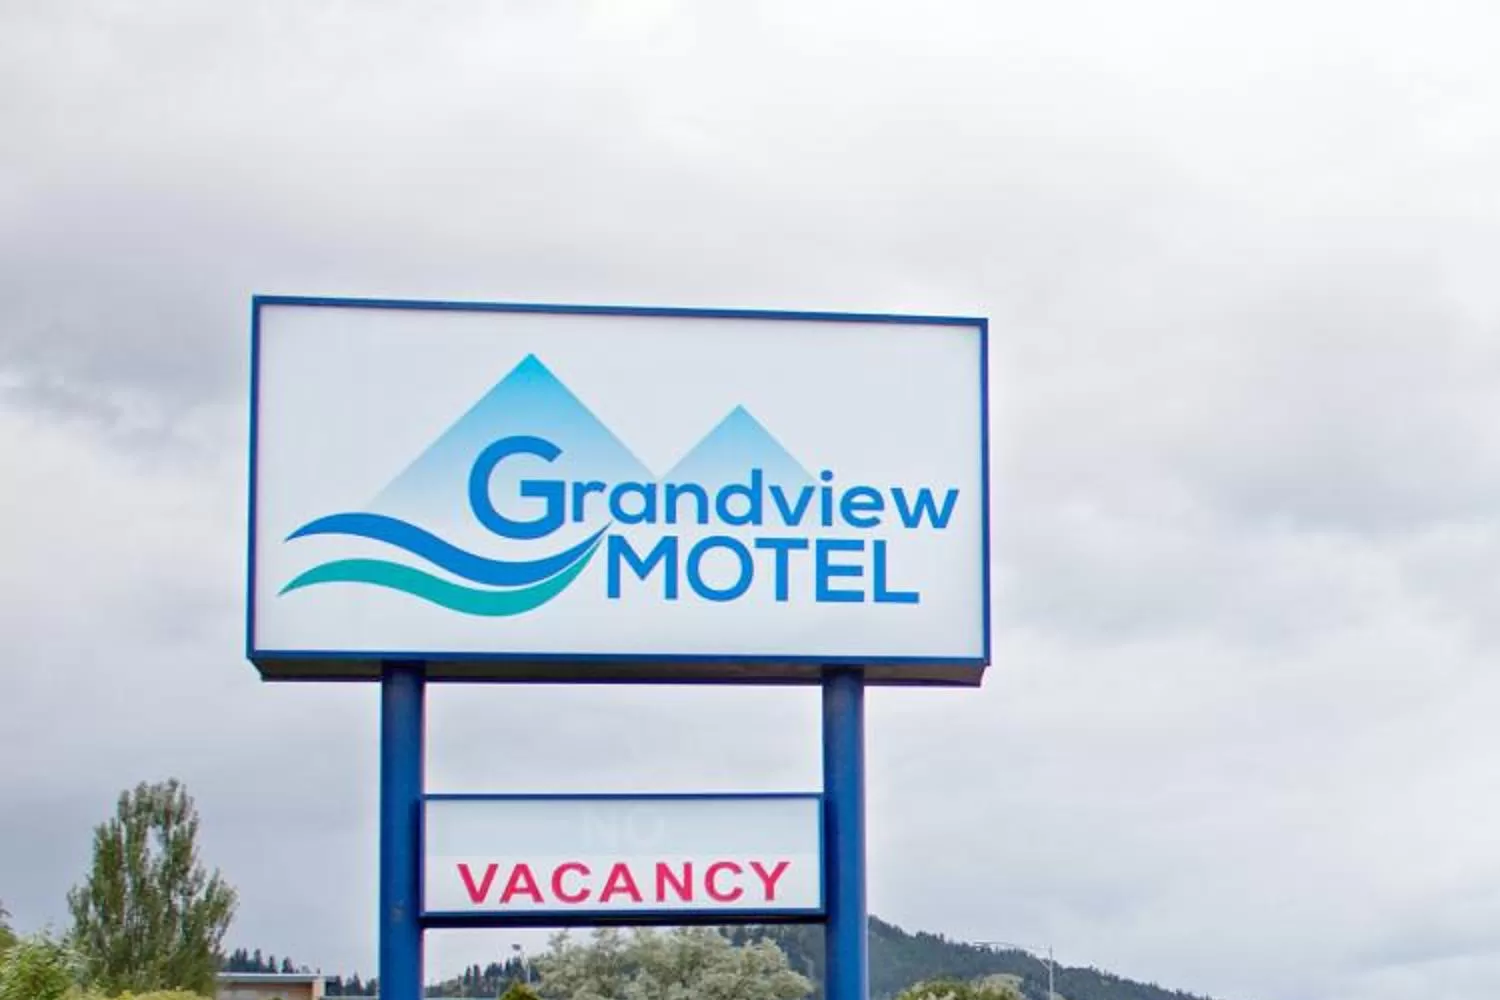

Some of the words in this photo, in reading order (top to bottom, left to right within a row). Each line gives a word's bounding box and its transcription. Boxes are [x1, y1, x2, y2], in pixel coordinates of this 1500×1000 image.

[467, 434, 960, 540] Grandview
[606, 533, 921, 604] MOTEL
[456, 861, 790, 904] VACANCY
